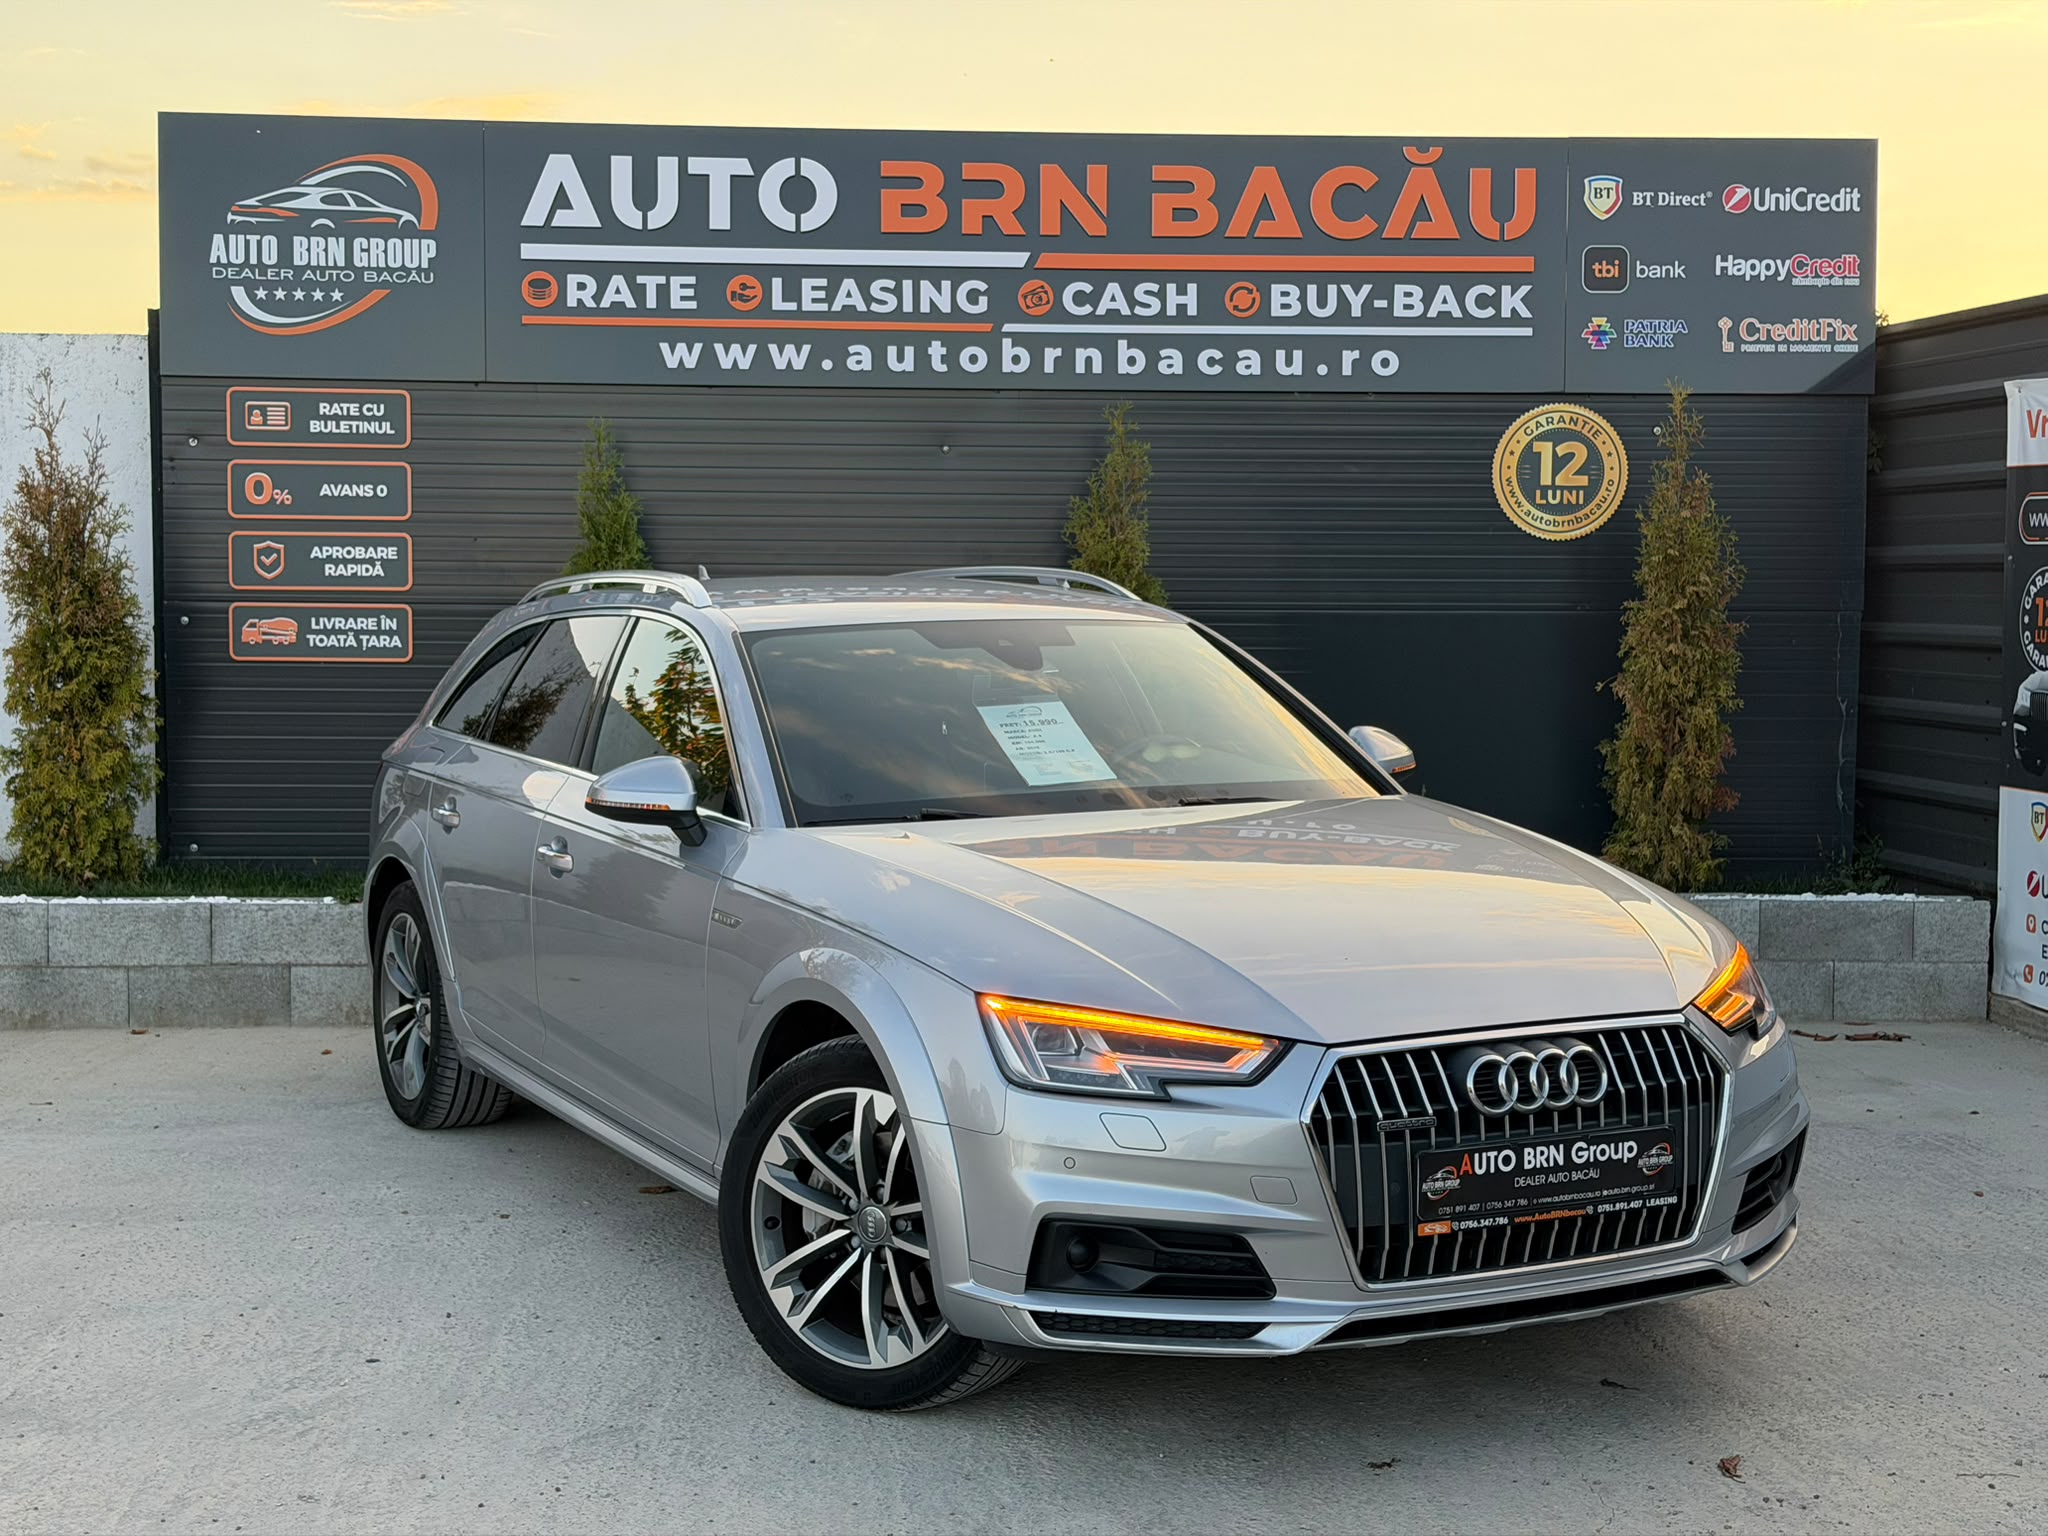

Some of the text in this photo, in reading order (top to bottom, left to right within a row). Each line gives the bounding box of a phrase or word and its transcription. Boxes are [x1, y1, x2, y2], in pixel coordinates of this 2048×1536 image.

[520, 146, 1537, 241] AUTO BRN BACĂU
[1593, 187, 1614, 200] BT
[1632, 191, 1655, 207] BT
[1754, 187, 1861, 212] UniCredit
[209, 233, 437, 269] AUTO BRN GROUP
[212, 267, 435, 284] DEALER AUTO BACĂU
[1592, 260, 1621, 279] tbi
[1636, 260, 1687, 279] bank
[1715, 254, 1860, 281] HappyCredit
[566, 273, 1534, 319] RATE LEASING CASH BUY-BACK
[1624, 319, 1689, 334] PATRIA
[1739, 317, 1859, 341] CreditFix
[1624, 334, 1675, 348] BANK
[659, 338, 1401, 377] www.autobrnbacau.ro
[319, 402, 385, 417] RATE CU
[309, 420, 395, 434] BULETINUL
[1523, 415, 1603, 440] GARANTIE
[1532, 441, 1589, 487] 12
[245, 472, 293, 505] 0%
[319, 484, 374, 497] AVANS
[1535, 490, 1585, 505] LUNI
[1505, 476, 1615, 528] www.autobrnbacau.ro
[310, 546, 398, 559] APROBARE
[325, 561, 385, 577] RAPIDĂ
[311, 615, 398, 630] LIVRARE ÎN
[306, 632, 357, 648] TOATĂ
[2024, 630, 2048, 669] GARA
[1459, 1140, 1638, 1176] AUTO BRN Group
[1514, 1168, 1600, 1188] DEALER AUTO BACĂU
[1438, 1205, 1454, 1215] 0751
[1455, 1204, 1467, 1213] 891
[1468, 1203, 1480, 1211] 407
[1486, 1200, 1502, 1210] 0756
[1503, 1199, 1515, 1207] 347
[1517, 1198, 1529, 1206] 786
[1460, 1216, 1509, 1230] 0756.347.786
[1597, 1199, 1643, 1213] 0751.891.407
[1646, 1195, 1678, 1207] LEASING
